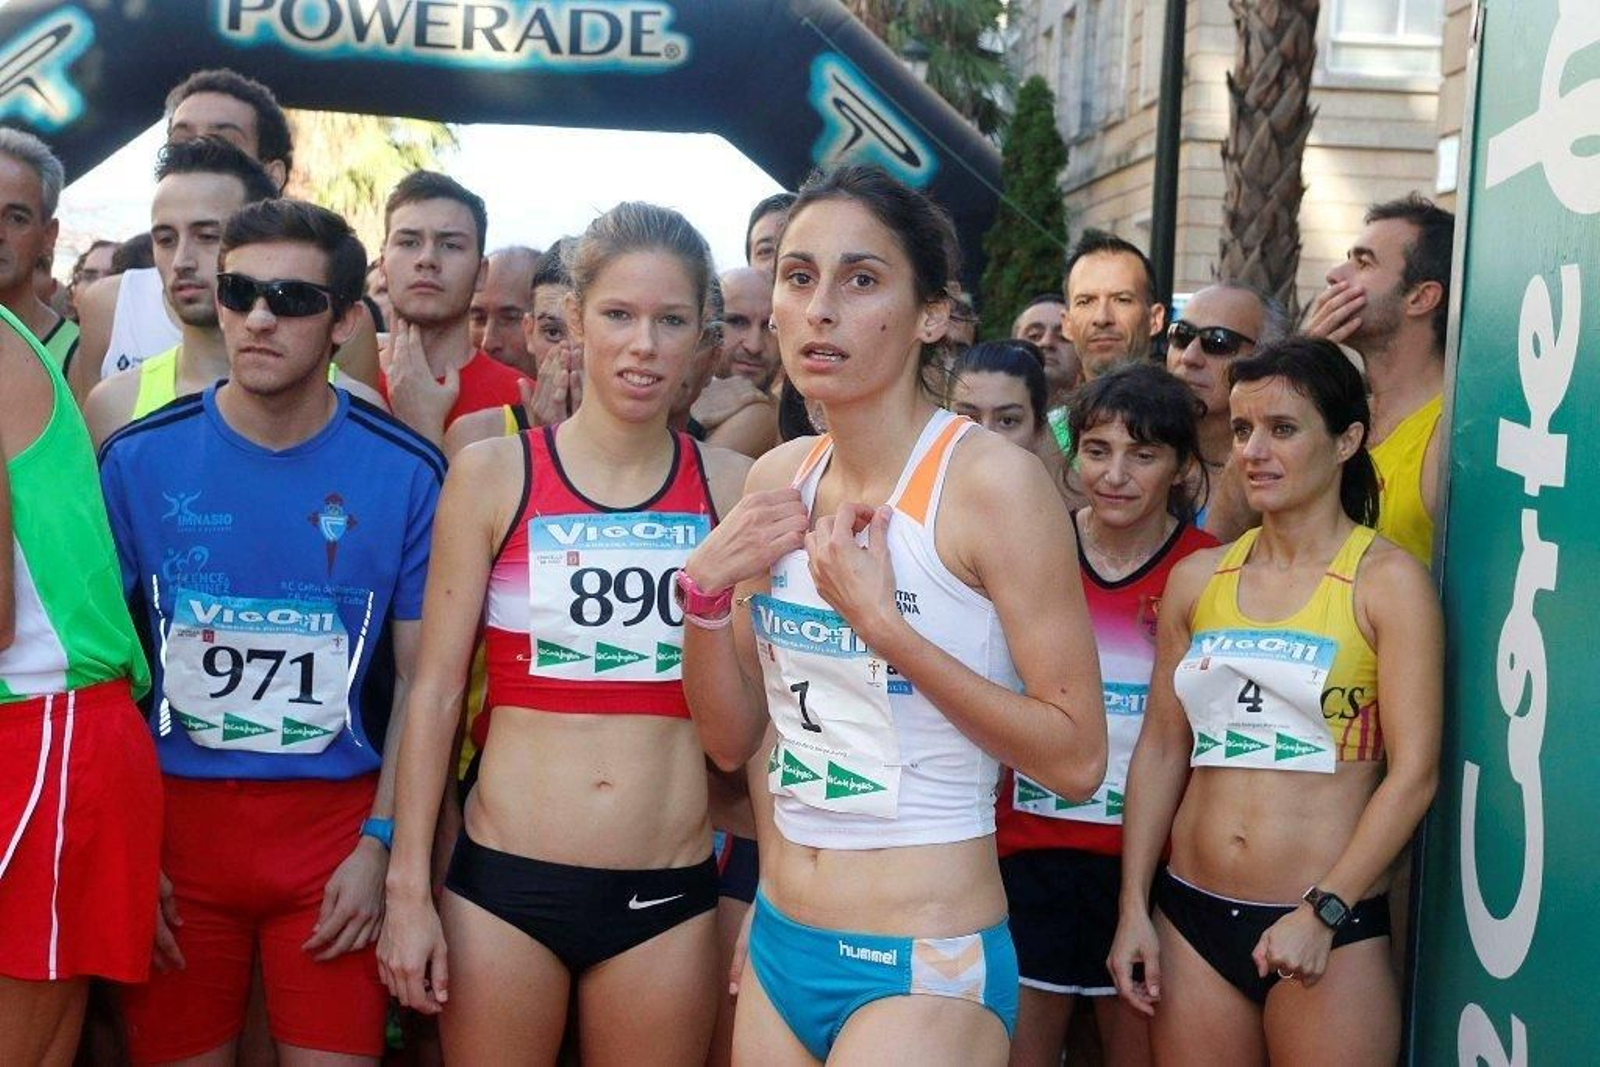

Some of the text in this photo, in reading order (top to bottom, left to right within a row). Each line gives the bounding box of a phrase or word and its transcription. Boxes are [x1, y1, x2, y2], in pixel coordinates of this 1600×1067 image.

[227, 0, 662, 59] POWERADE
[569, 566, 685, 628] 890
[1461, 263, 1581, 980] Corte
[202, 645, 324, 705] 971
[1237, 679, 1264, 713] 4
[1319, 686, 1365, 720] CS
[790, 680, 823, 734] 1
[838, 939, 898, 966] hummel
